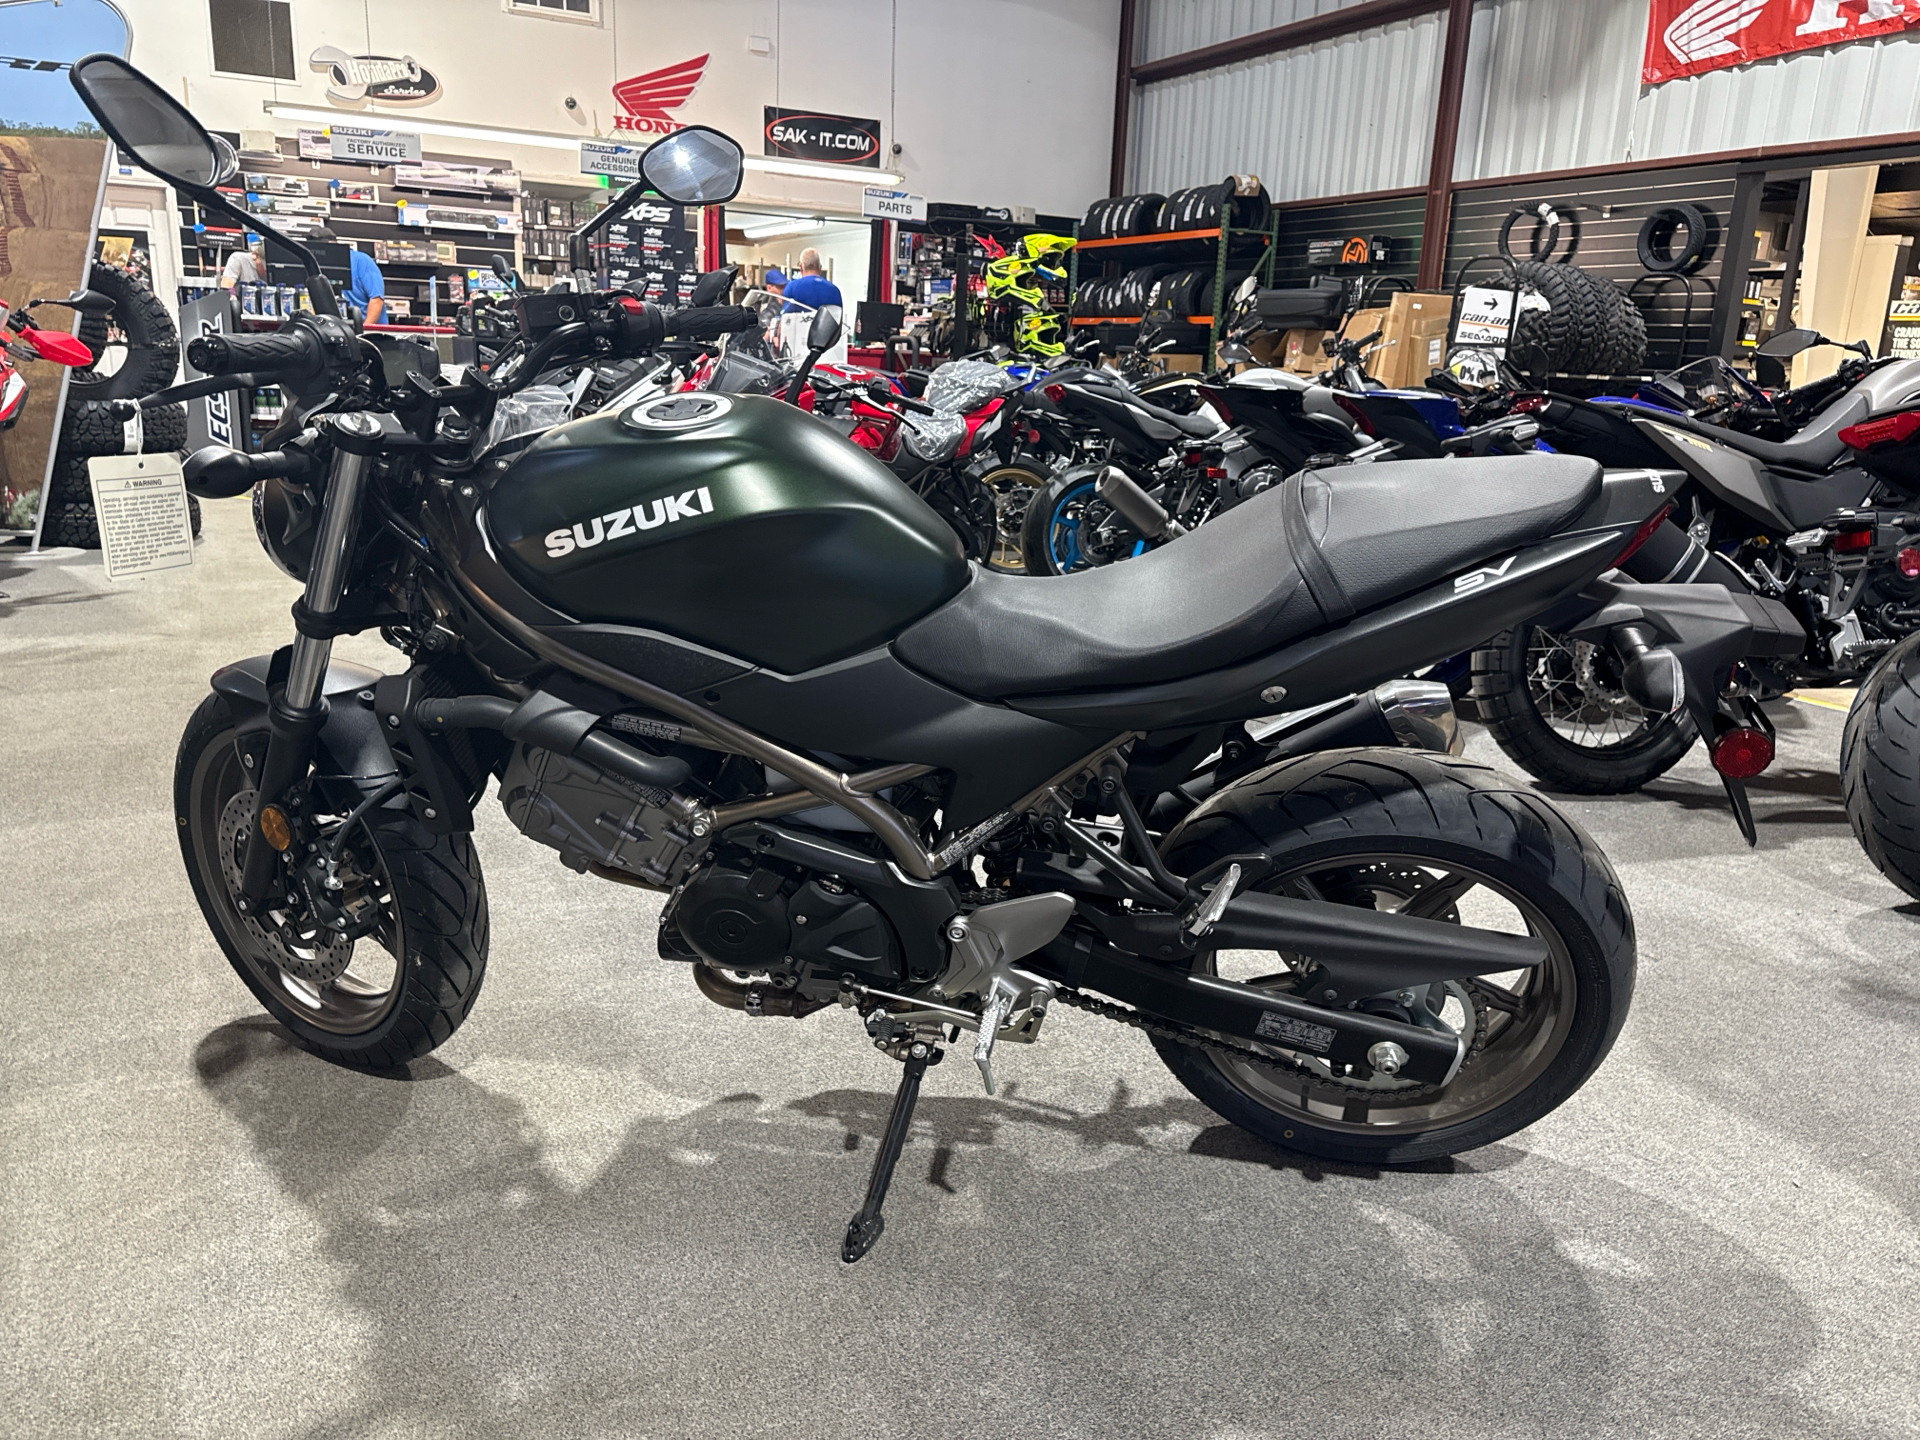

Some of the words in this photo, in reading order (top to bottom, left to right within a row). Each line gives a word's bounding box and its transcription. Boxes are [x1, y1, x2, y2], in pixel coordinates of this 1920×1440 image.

[345, 60, 408, 85] HondaPro
[384, 85, 427, 96] Service
[332, 126, 372, 136] SUZUKI
[613, 116, 689, 134] HON
[772, 126, 808, 144] SAK
[819, 131, 870, 151] IT.COM
[347, 143, 407, 158] SERVICE
[582, 143, 616, 153] SUZUKI
[600, 155, 638, 166] GENUINE
[590, 162, 639, 174] ACCESSORI
[865, 188, 893, 198] SUZUKI
[621, 202, 673, 222] XPS
[878, 201, 913, 215] PARTS
[1892, 338, 1910, 349] THE
[133, 478, 162, 487] WARNING
[544, 486, 714, 558] SUZUKI
[1454, 555, 1517, 594] SV
